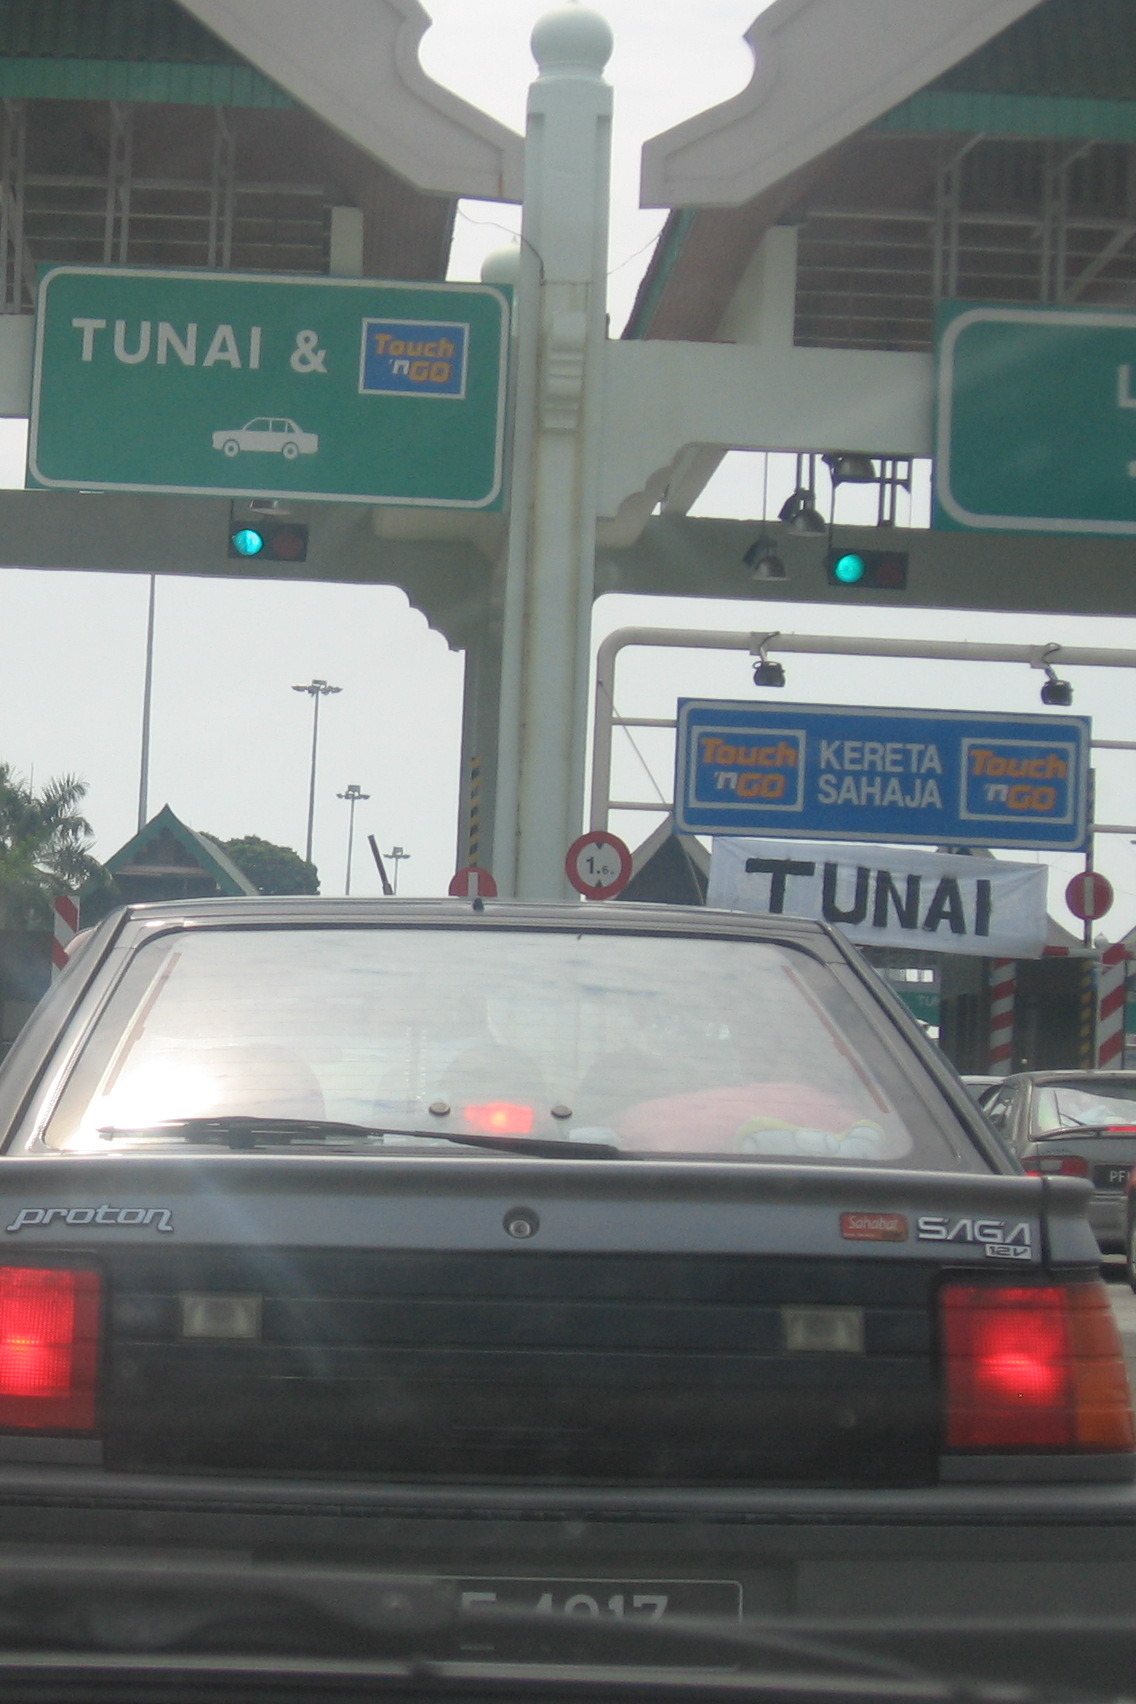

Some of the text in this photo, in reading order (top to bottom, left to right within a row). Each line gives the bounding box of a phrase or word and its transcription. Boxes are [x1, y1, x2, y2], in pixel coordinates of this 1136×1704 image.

[71, 317, 328, 373] TUNAI &
[374, 333, 457, 358] Touch
[701, 737, 799, 767] Touch
[819, 739, 943, 774] KERETA
[970, 748, 1069, 779] Touch
[816, 773, 943, 809] SAHAJA
[745, 857, 991, 937] TUNAI
[6, 1204, 174, 1232] proton
[918, 1216, 1031, 1246] SAGA
